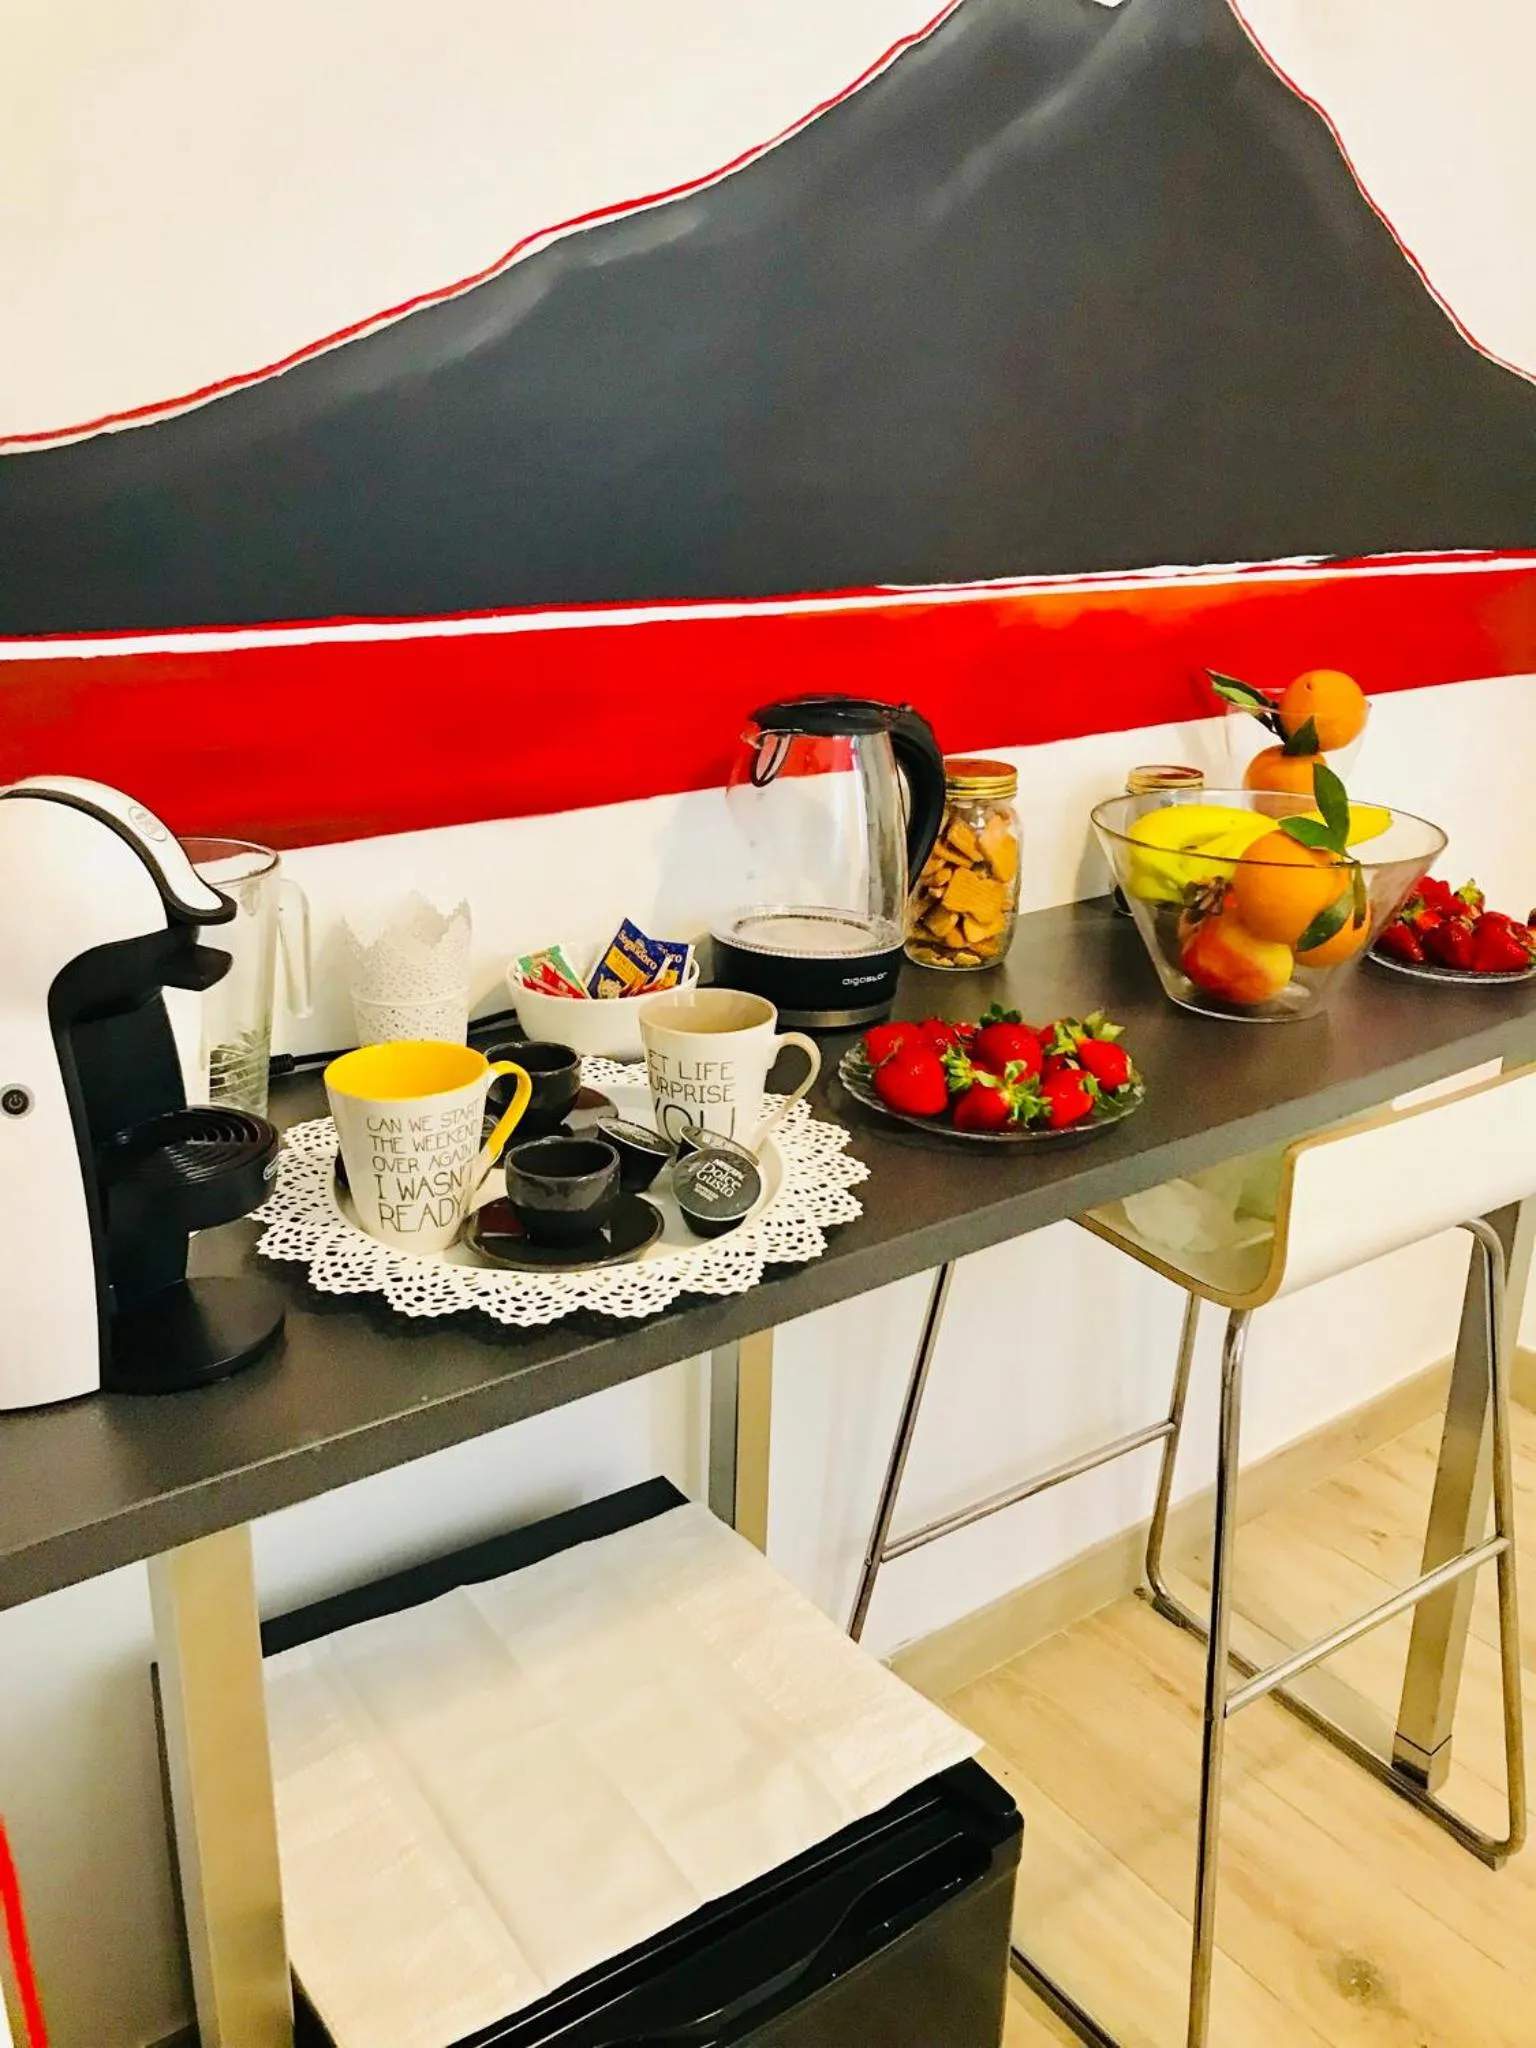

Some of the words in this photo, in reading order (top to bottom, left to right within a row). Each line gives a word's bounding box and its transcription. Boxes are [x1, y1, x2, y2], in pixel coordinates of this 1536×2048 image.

[648, 1048, 669, 1074] ET
[678, 1060, 735, 1081] LIFE
[650, 1075, 736, 1104] URPRISE
[366, 1115, 402, 1133] CAN
[408, 1114, 434, 1132] WE
[440, 1097, 480, 1128] START
[368, 1134, 406, 1154] THE
[372, 1155, 420, 1174] OVER
[700, 1161, 742, 1190] Dolce
[373, 1174, 387, 1200] I
[696, 1170, 734, 1198] Gusto
[378, 1189, 466, 1233] READY
